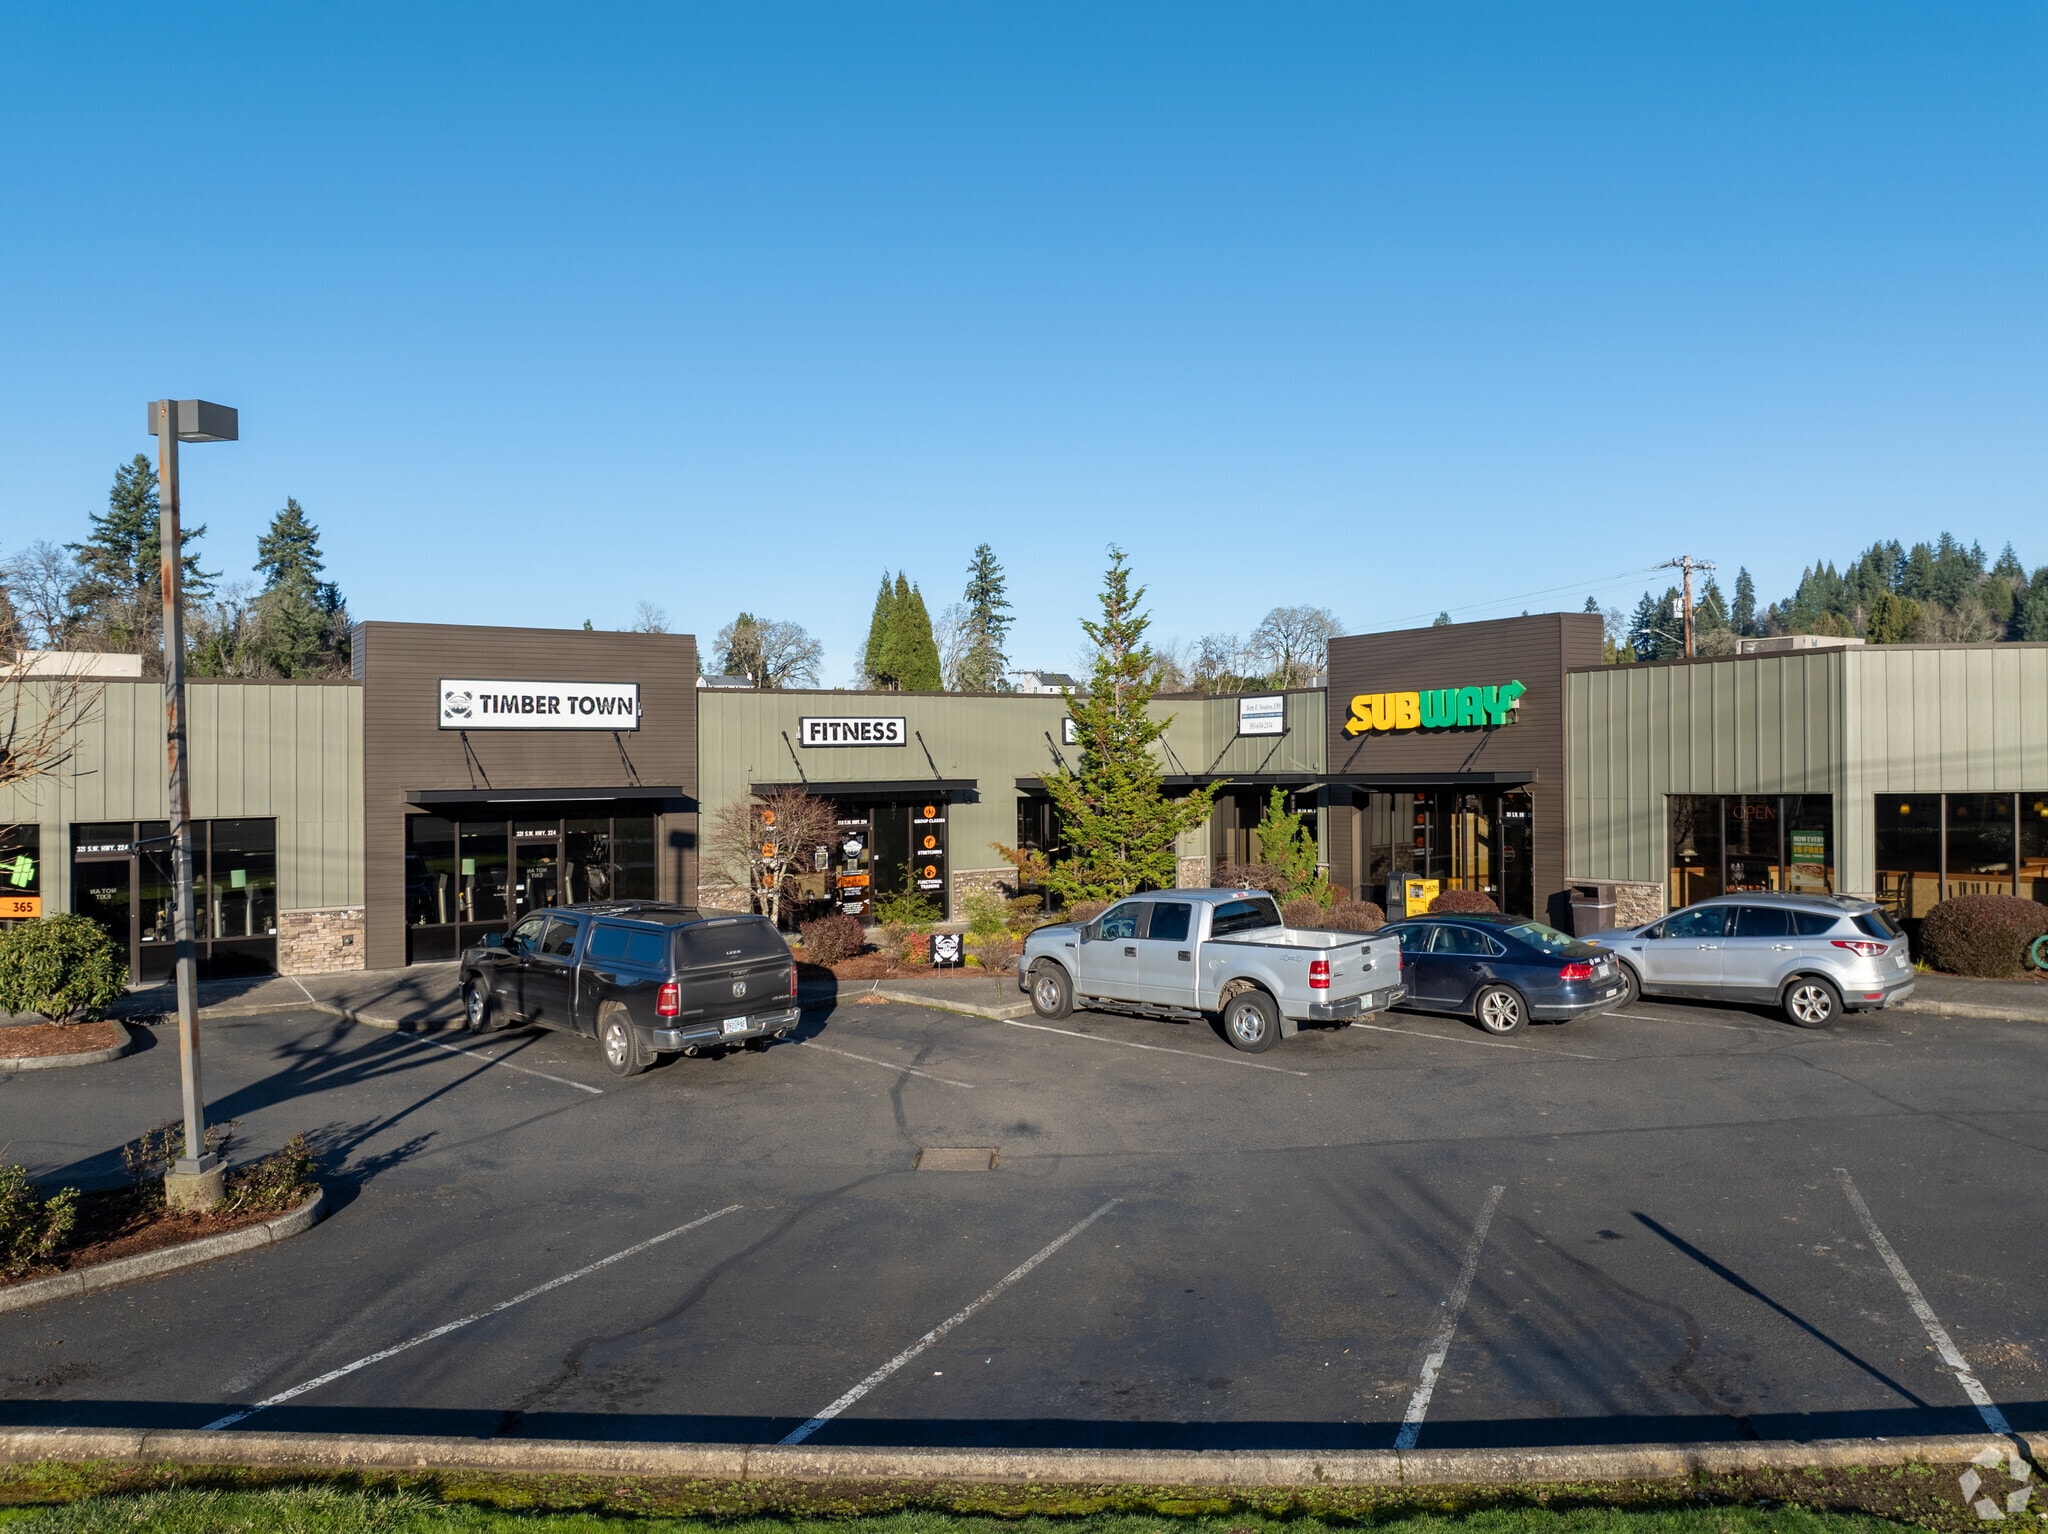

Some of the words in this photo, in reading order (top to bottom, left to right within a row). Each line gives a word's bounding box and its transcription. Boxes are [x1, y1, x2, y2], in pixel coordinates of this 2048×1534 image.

[480, 695, 560, 714] TIMBER
[567, 697, 633, 715] TOWN
[1345, 680, 1527, 735] SUBWAY
[810, 722, 898, 741] FITNESS
[1733, 805, 1776, 820] OPEN
[1803, 846, 1824, 854] FREE
[13, 902, 33, 912] 365
